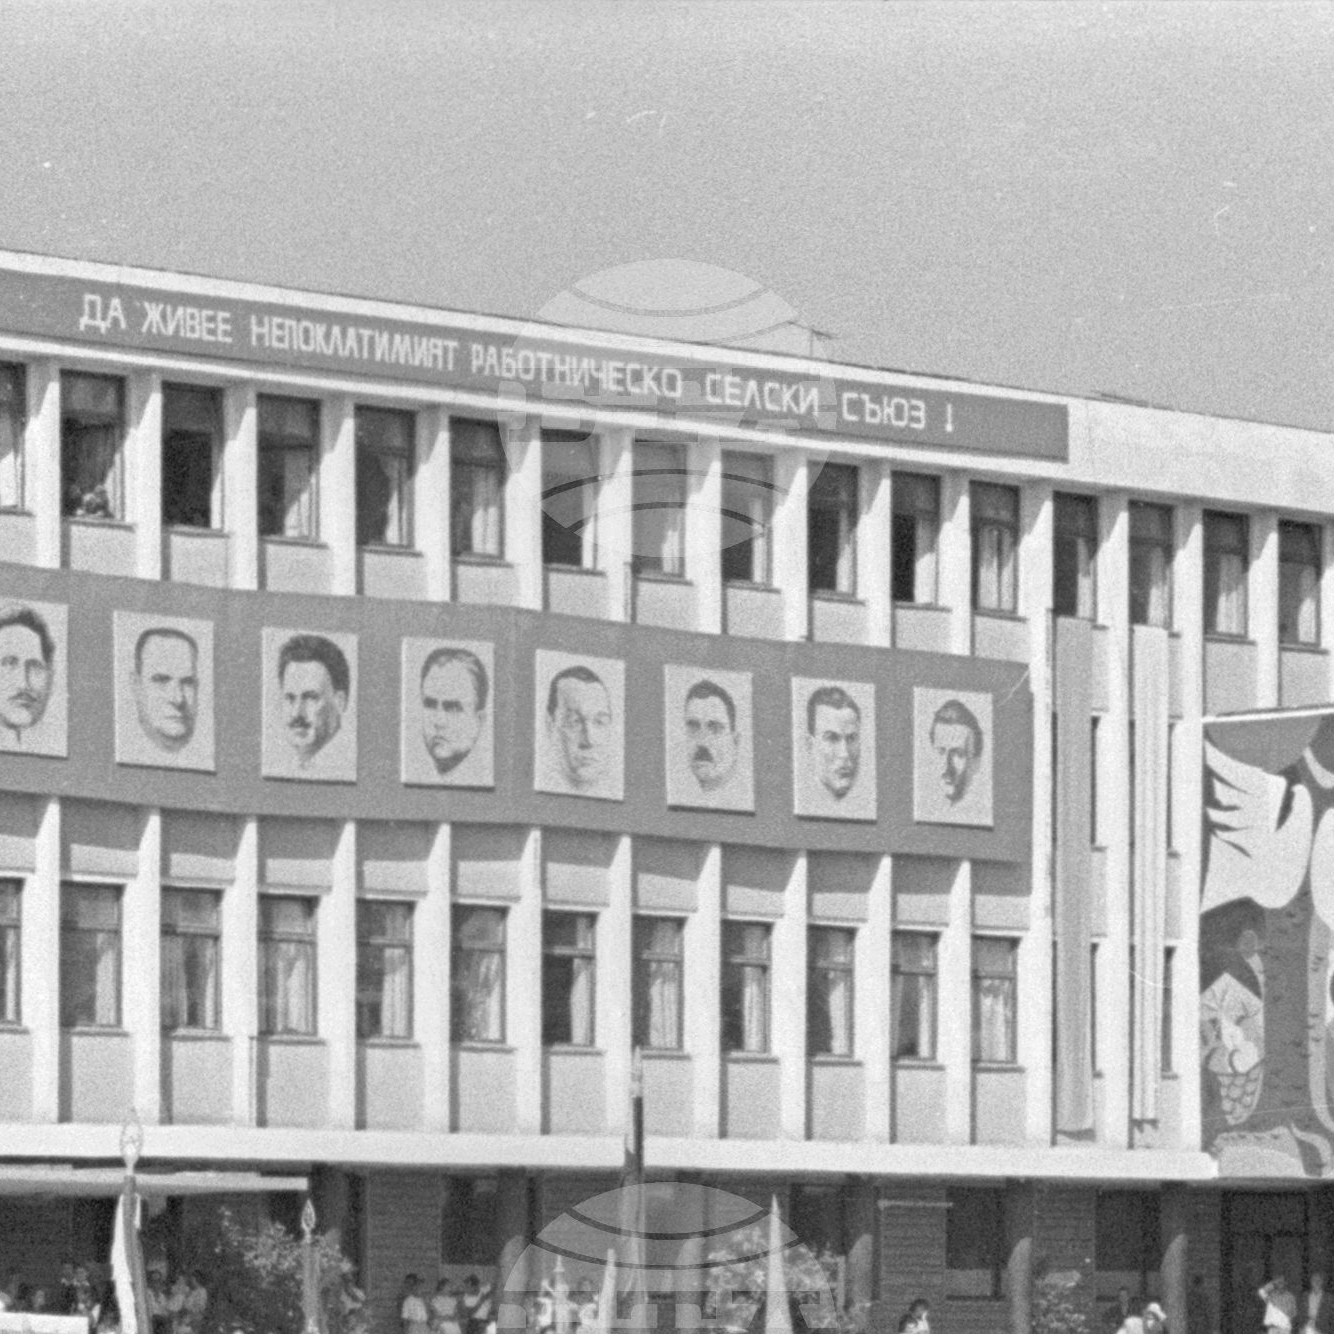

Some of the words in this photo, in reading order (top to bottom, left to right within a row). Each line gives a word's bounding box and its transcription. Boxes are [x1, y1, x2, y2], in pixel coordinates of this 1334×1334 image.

[79, 294, 127, 333] ДА
[141, 302, 233, 343] ЖИВЕЕ
[251, 316, 459, 372] НЕПОКЛАТИМИЯТ
[471, 343, 683, 399] РАБОТНИЧЕСКО
[705, 373, 820, 417] СЕЛСКИ
[842, 391, 927, 430] СЪЮЗ
